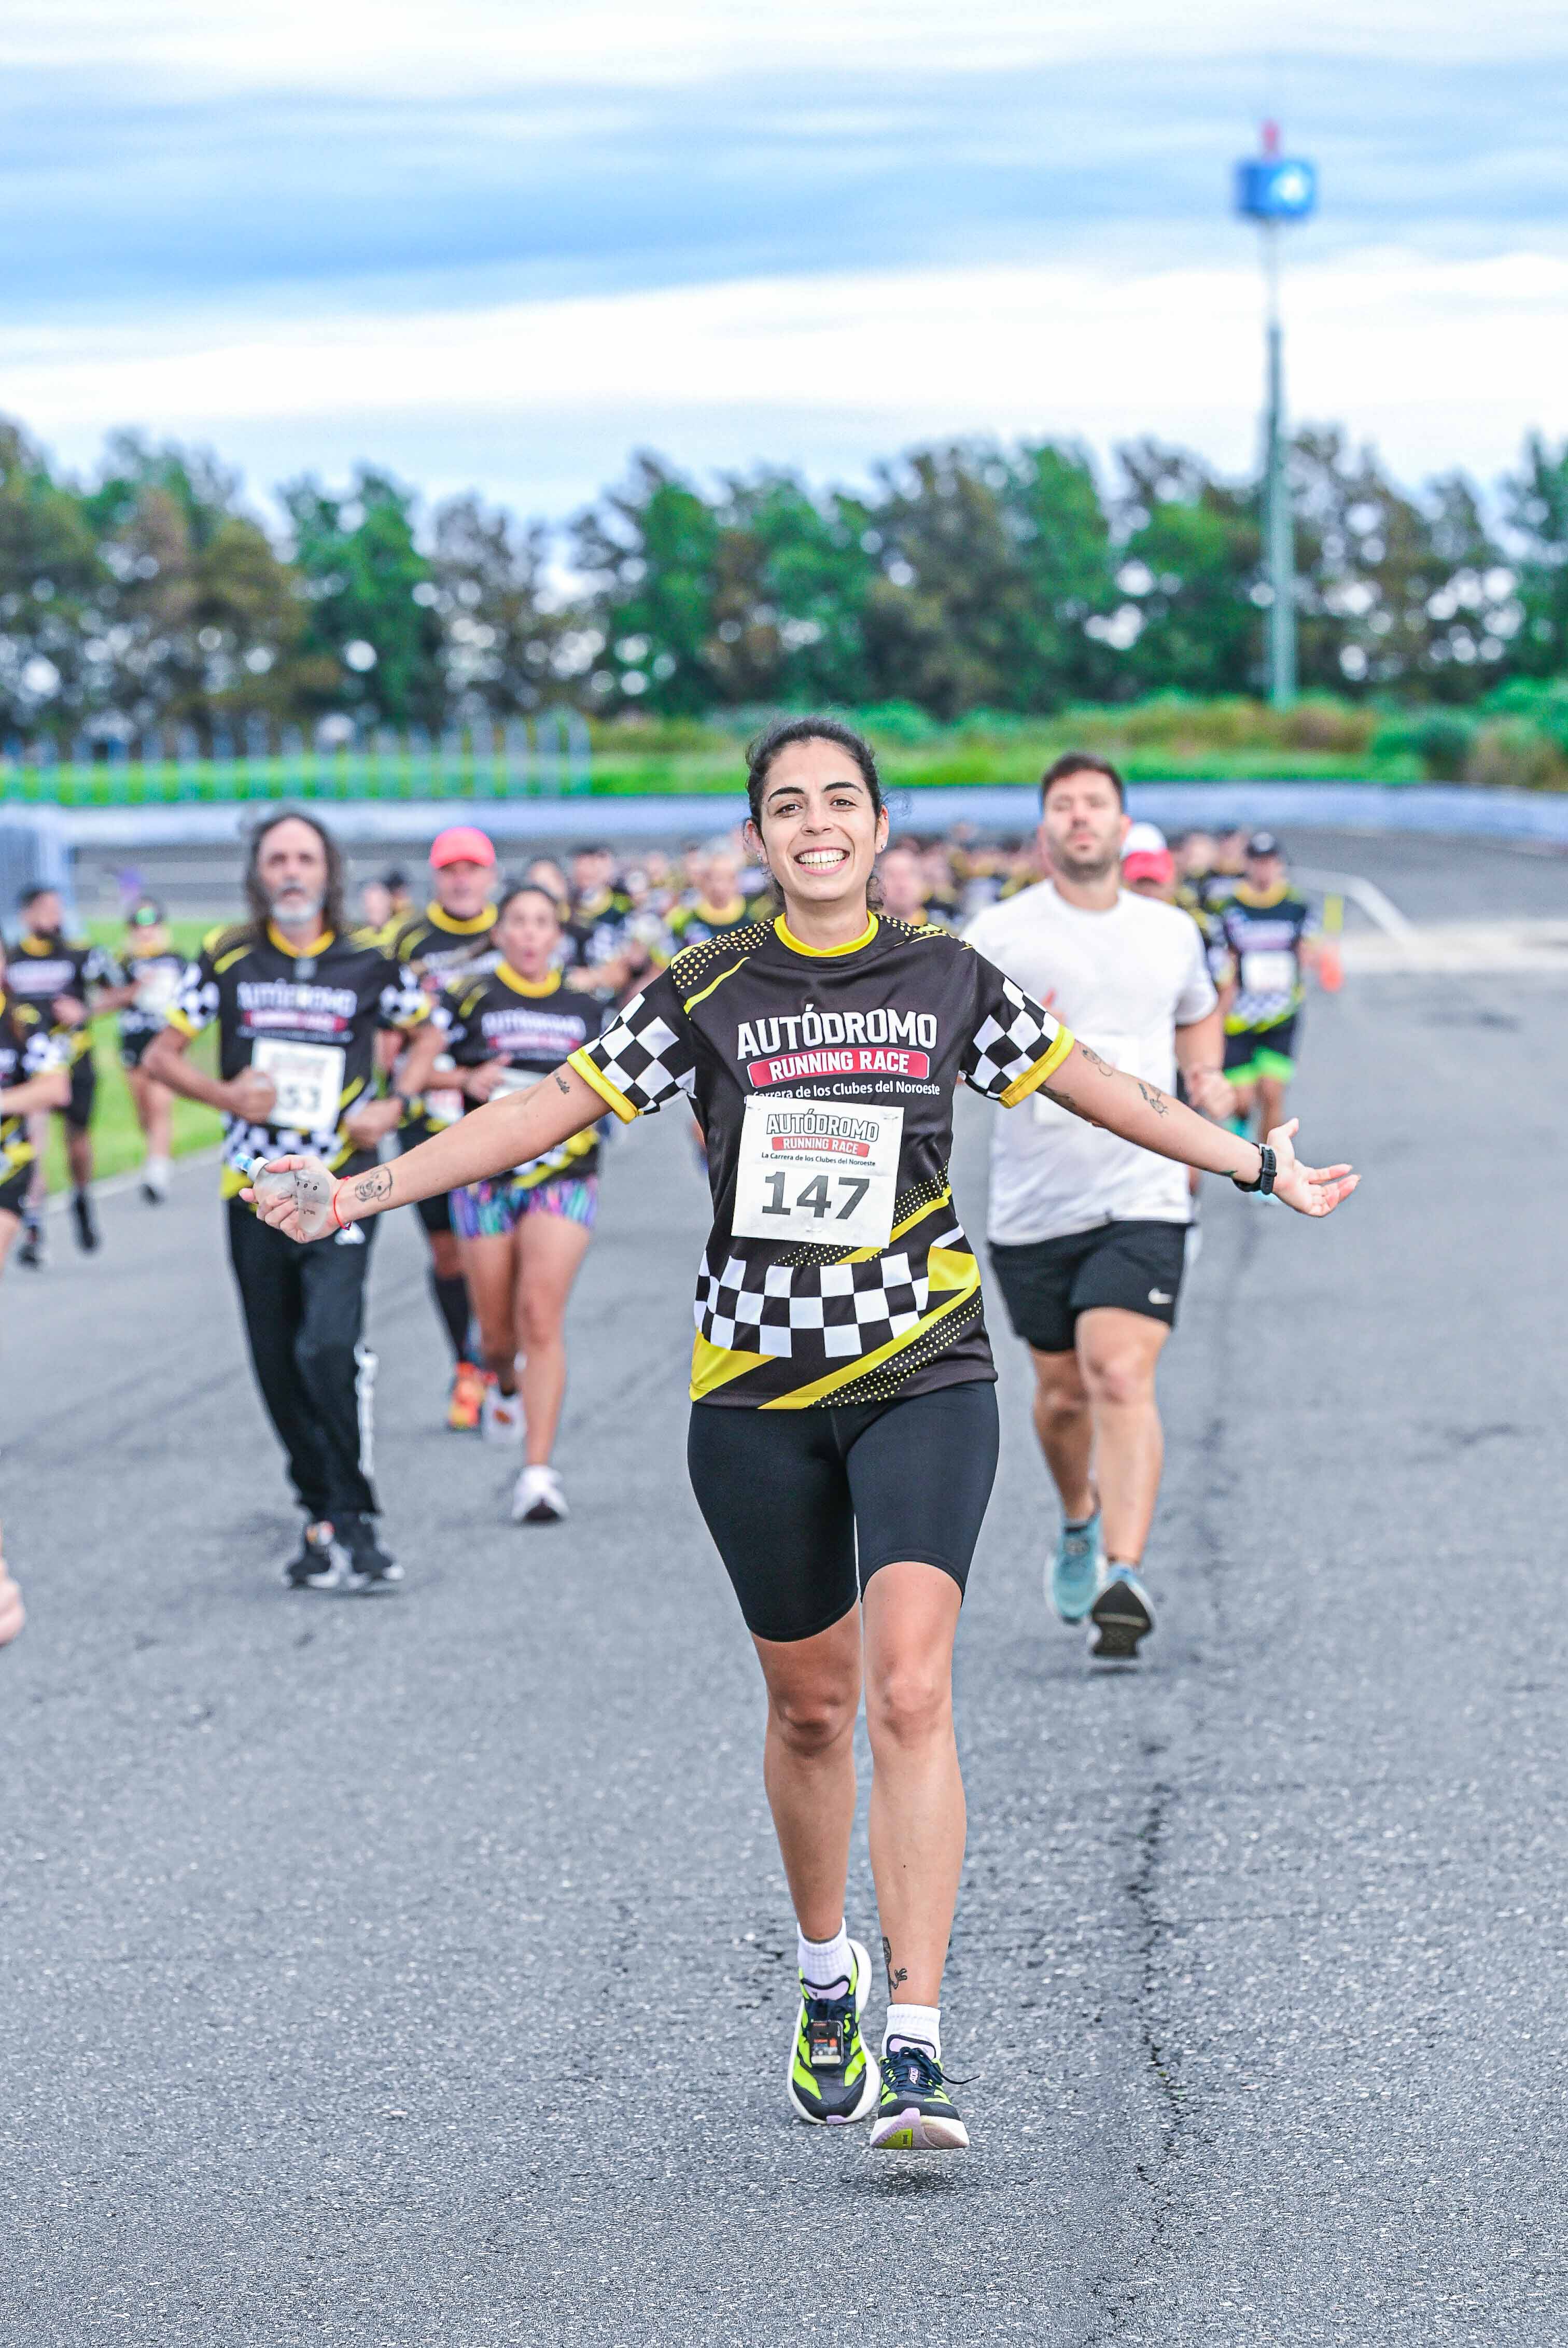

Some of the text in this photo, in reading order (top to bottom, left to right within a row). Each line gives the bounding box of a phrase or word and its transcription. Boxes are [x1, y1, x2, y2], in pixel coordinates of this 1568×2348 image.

[737, 1003, 937, 1060] AUTÓDROMO
[768, 1051, 910, 1082] RUNNING RACE
[795, 1085, 811, 1098] de
[813, 1085, 831, 1097] los
[832, 1082, 873, 1096] Clubes
[875, 1080, 893, 1093] del
[895, 1081, 941, 1096] Noroeste
[766, 1108, 879, 1142] AUTÓDROMO
[770, 1153, 794, 1161] Carrera
[848, 1158, 876, 1167] Noroeste
[782, 1137, 859, 1155] RUNNING RACE
[762, 1171, 870, 1220] 147
